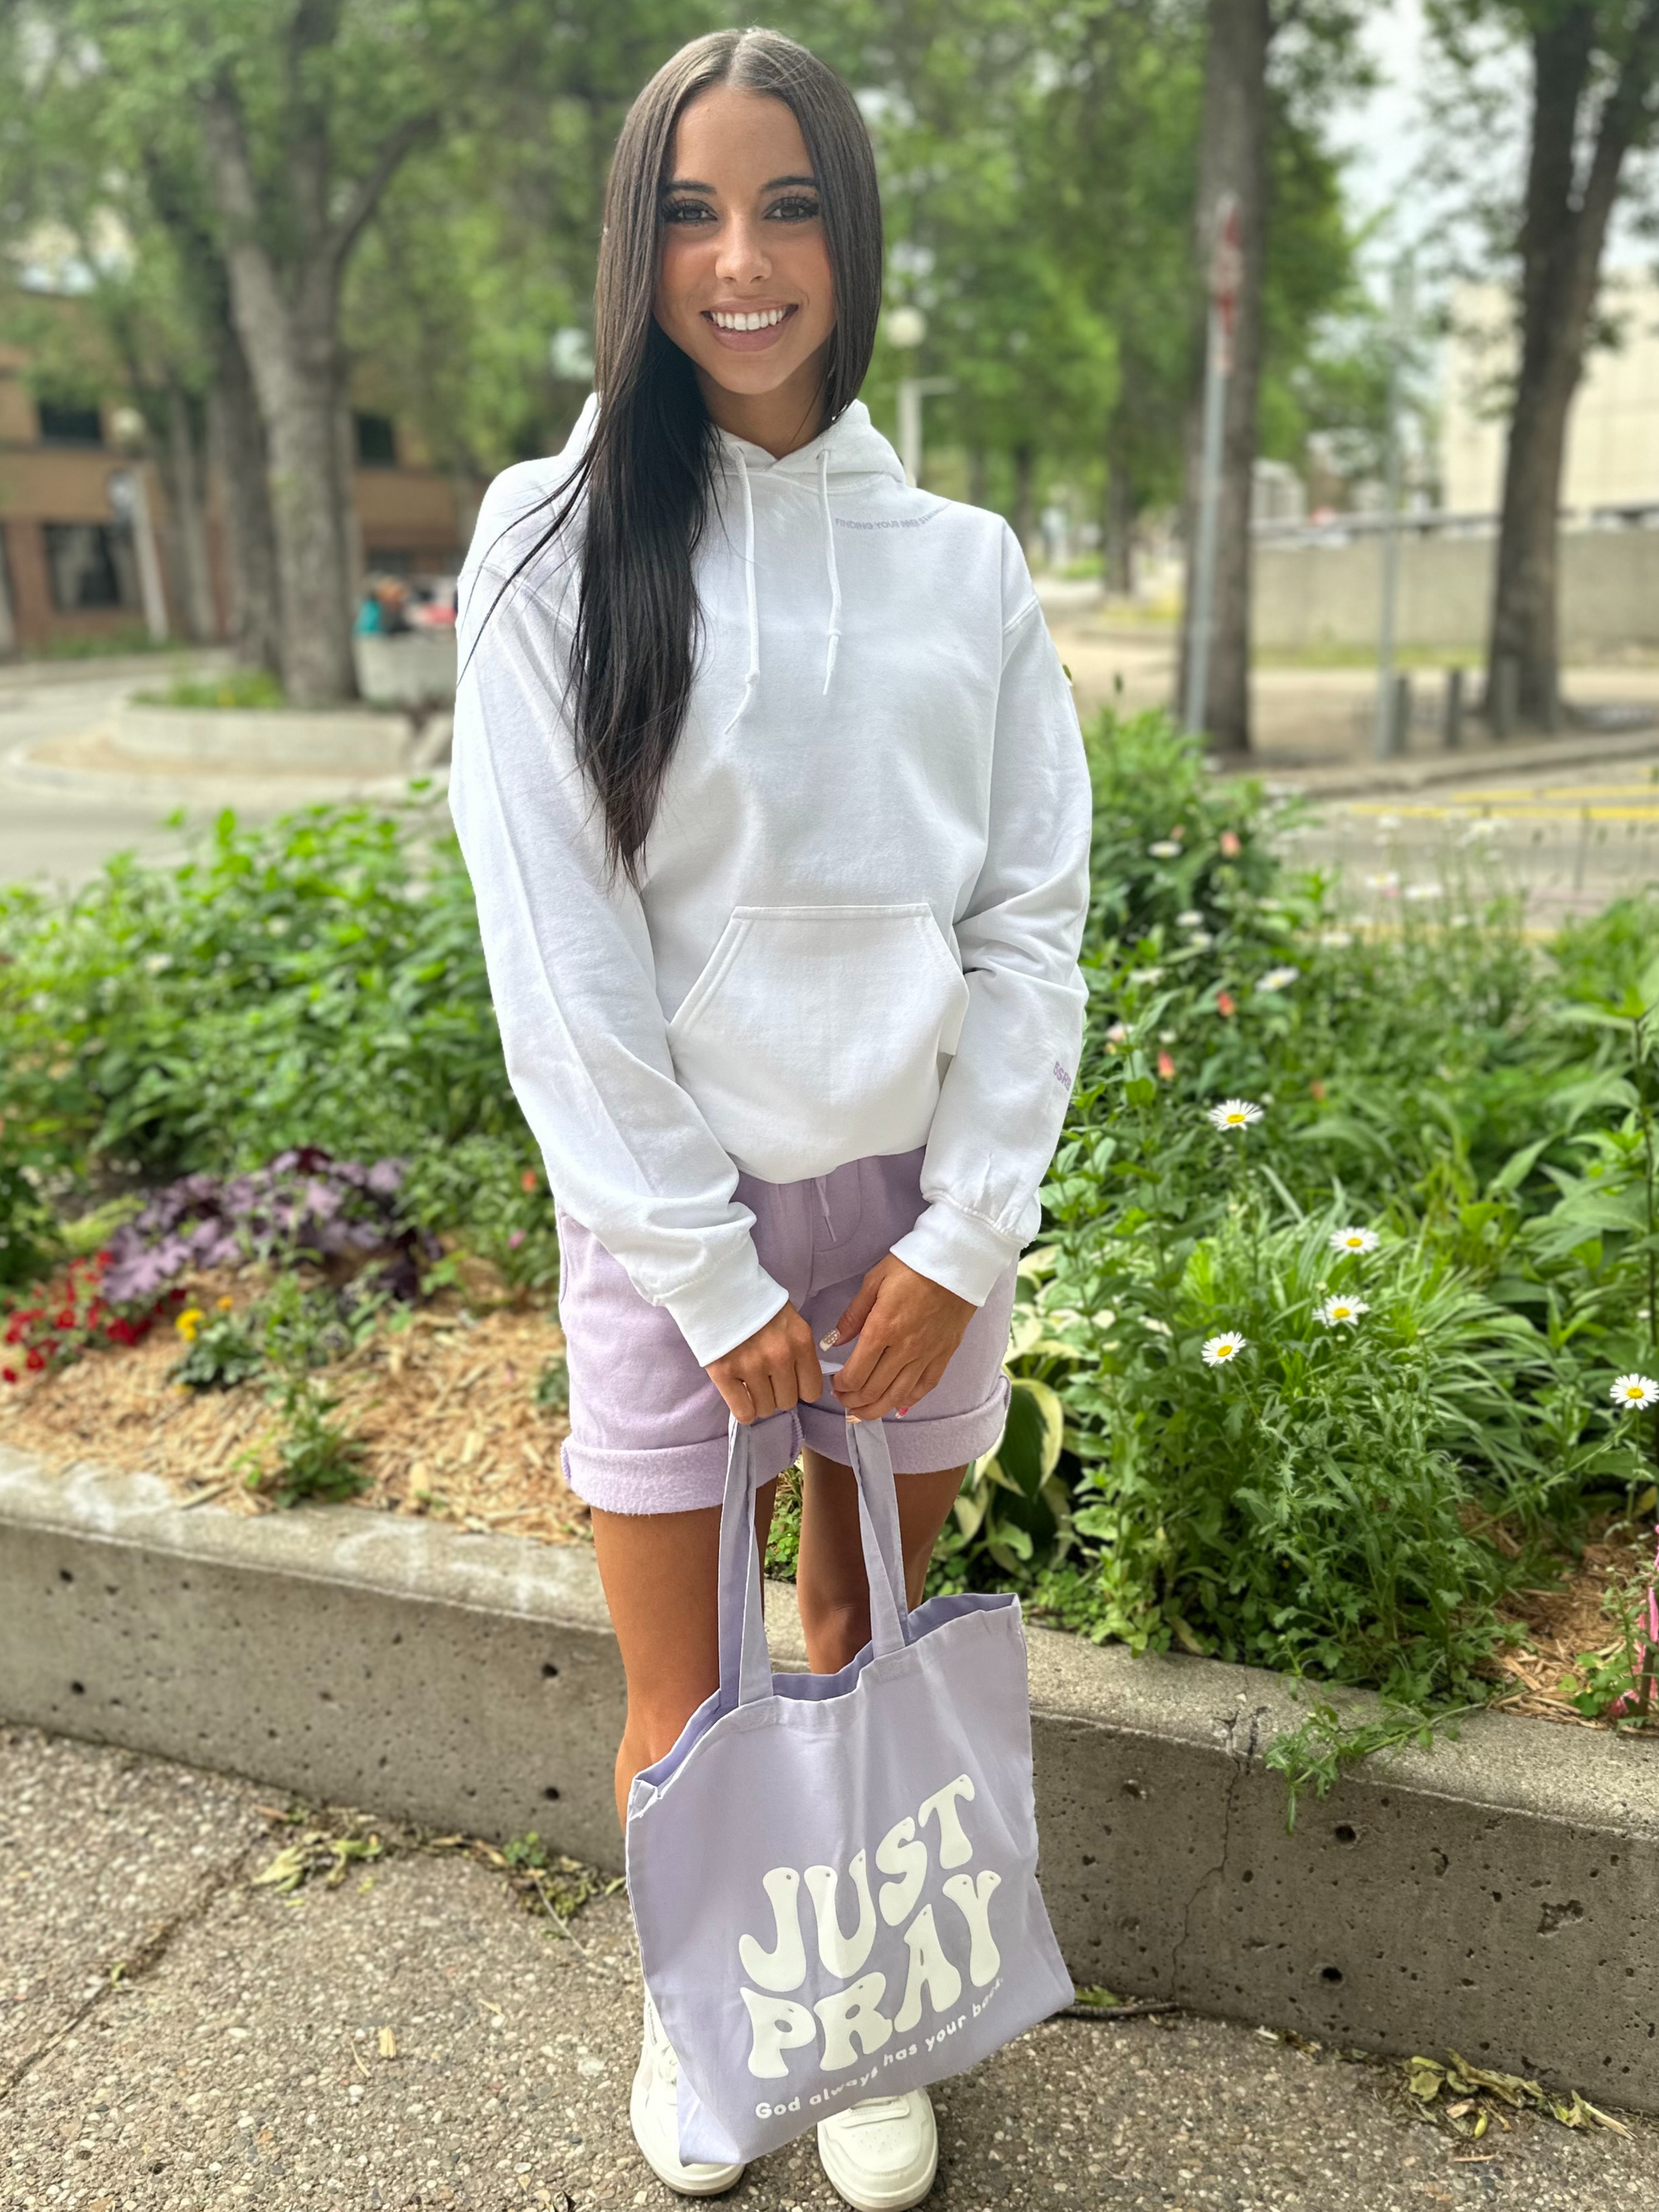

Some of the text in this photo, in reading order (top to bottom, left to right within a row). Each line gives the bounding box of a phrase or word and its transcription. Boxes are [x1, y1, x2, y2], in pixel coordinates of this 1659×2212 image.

[834, 518, 873, 530] FINDING
[873, 520, 900, 529] YOUR
[739, 1774, 975, 1992] JUST
[740, 1870, 1002, 2078] PRAY
[755, 2096, 801, 2120] God
[809, 2065, 878, 2106] always
[883, 2043, 918, 2068] has
[924, 2014, 967, 2052] your
